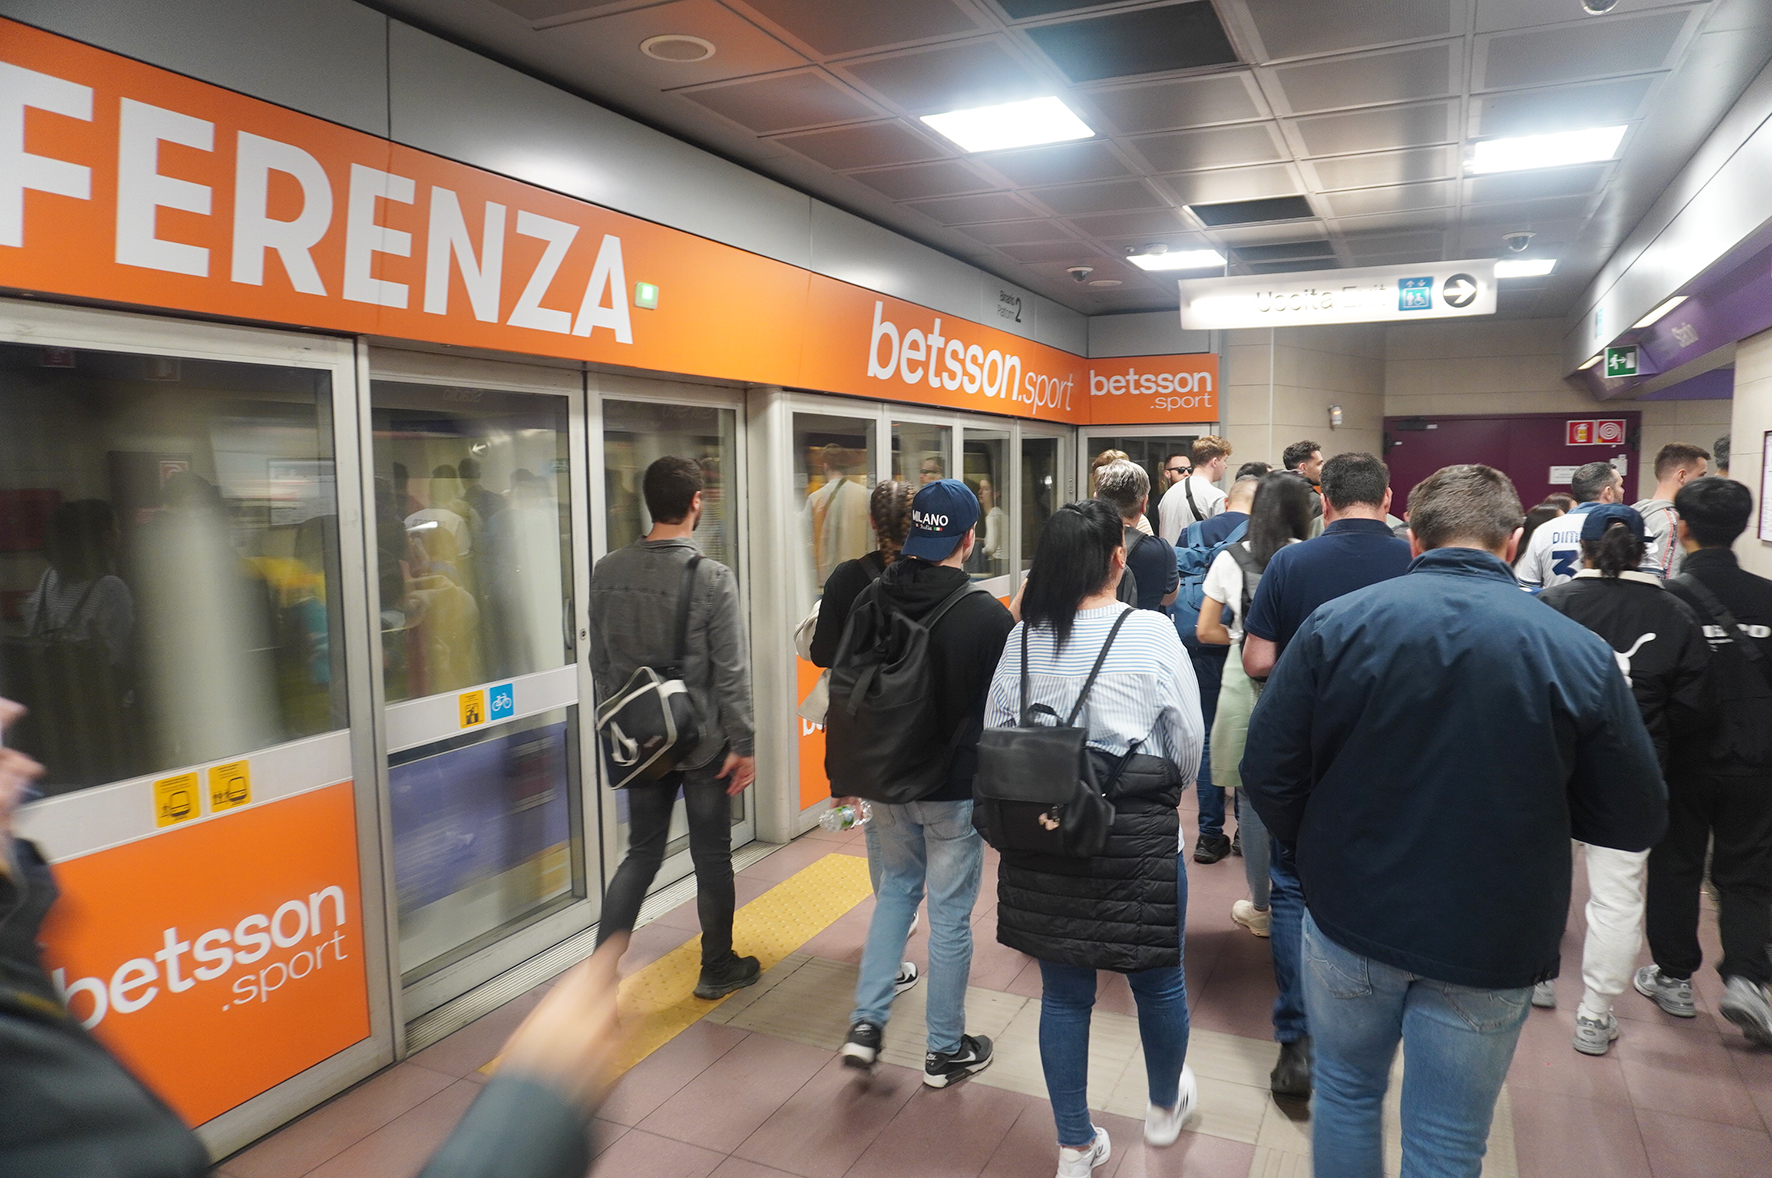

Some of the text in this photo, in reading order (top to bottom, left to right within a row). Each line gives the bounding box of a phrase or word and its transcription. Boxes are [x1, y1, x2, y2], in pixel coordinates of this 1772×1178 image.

[0, 61, 634, 345] FERENZA
[1014, 297, 1022, 323] 2
[1089, 368, 1213, 396] betsson
[51, 884, 346, 1031] betsson
